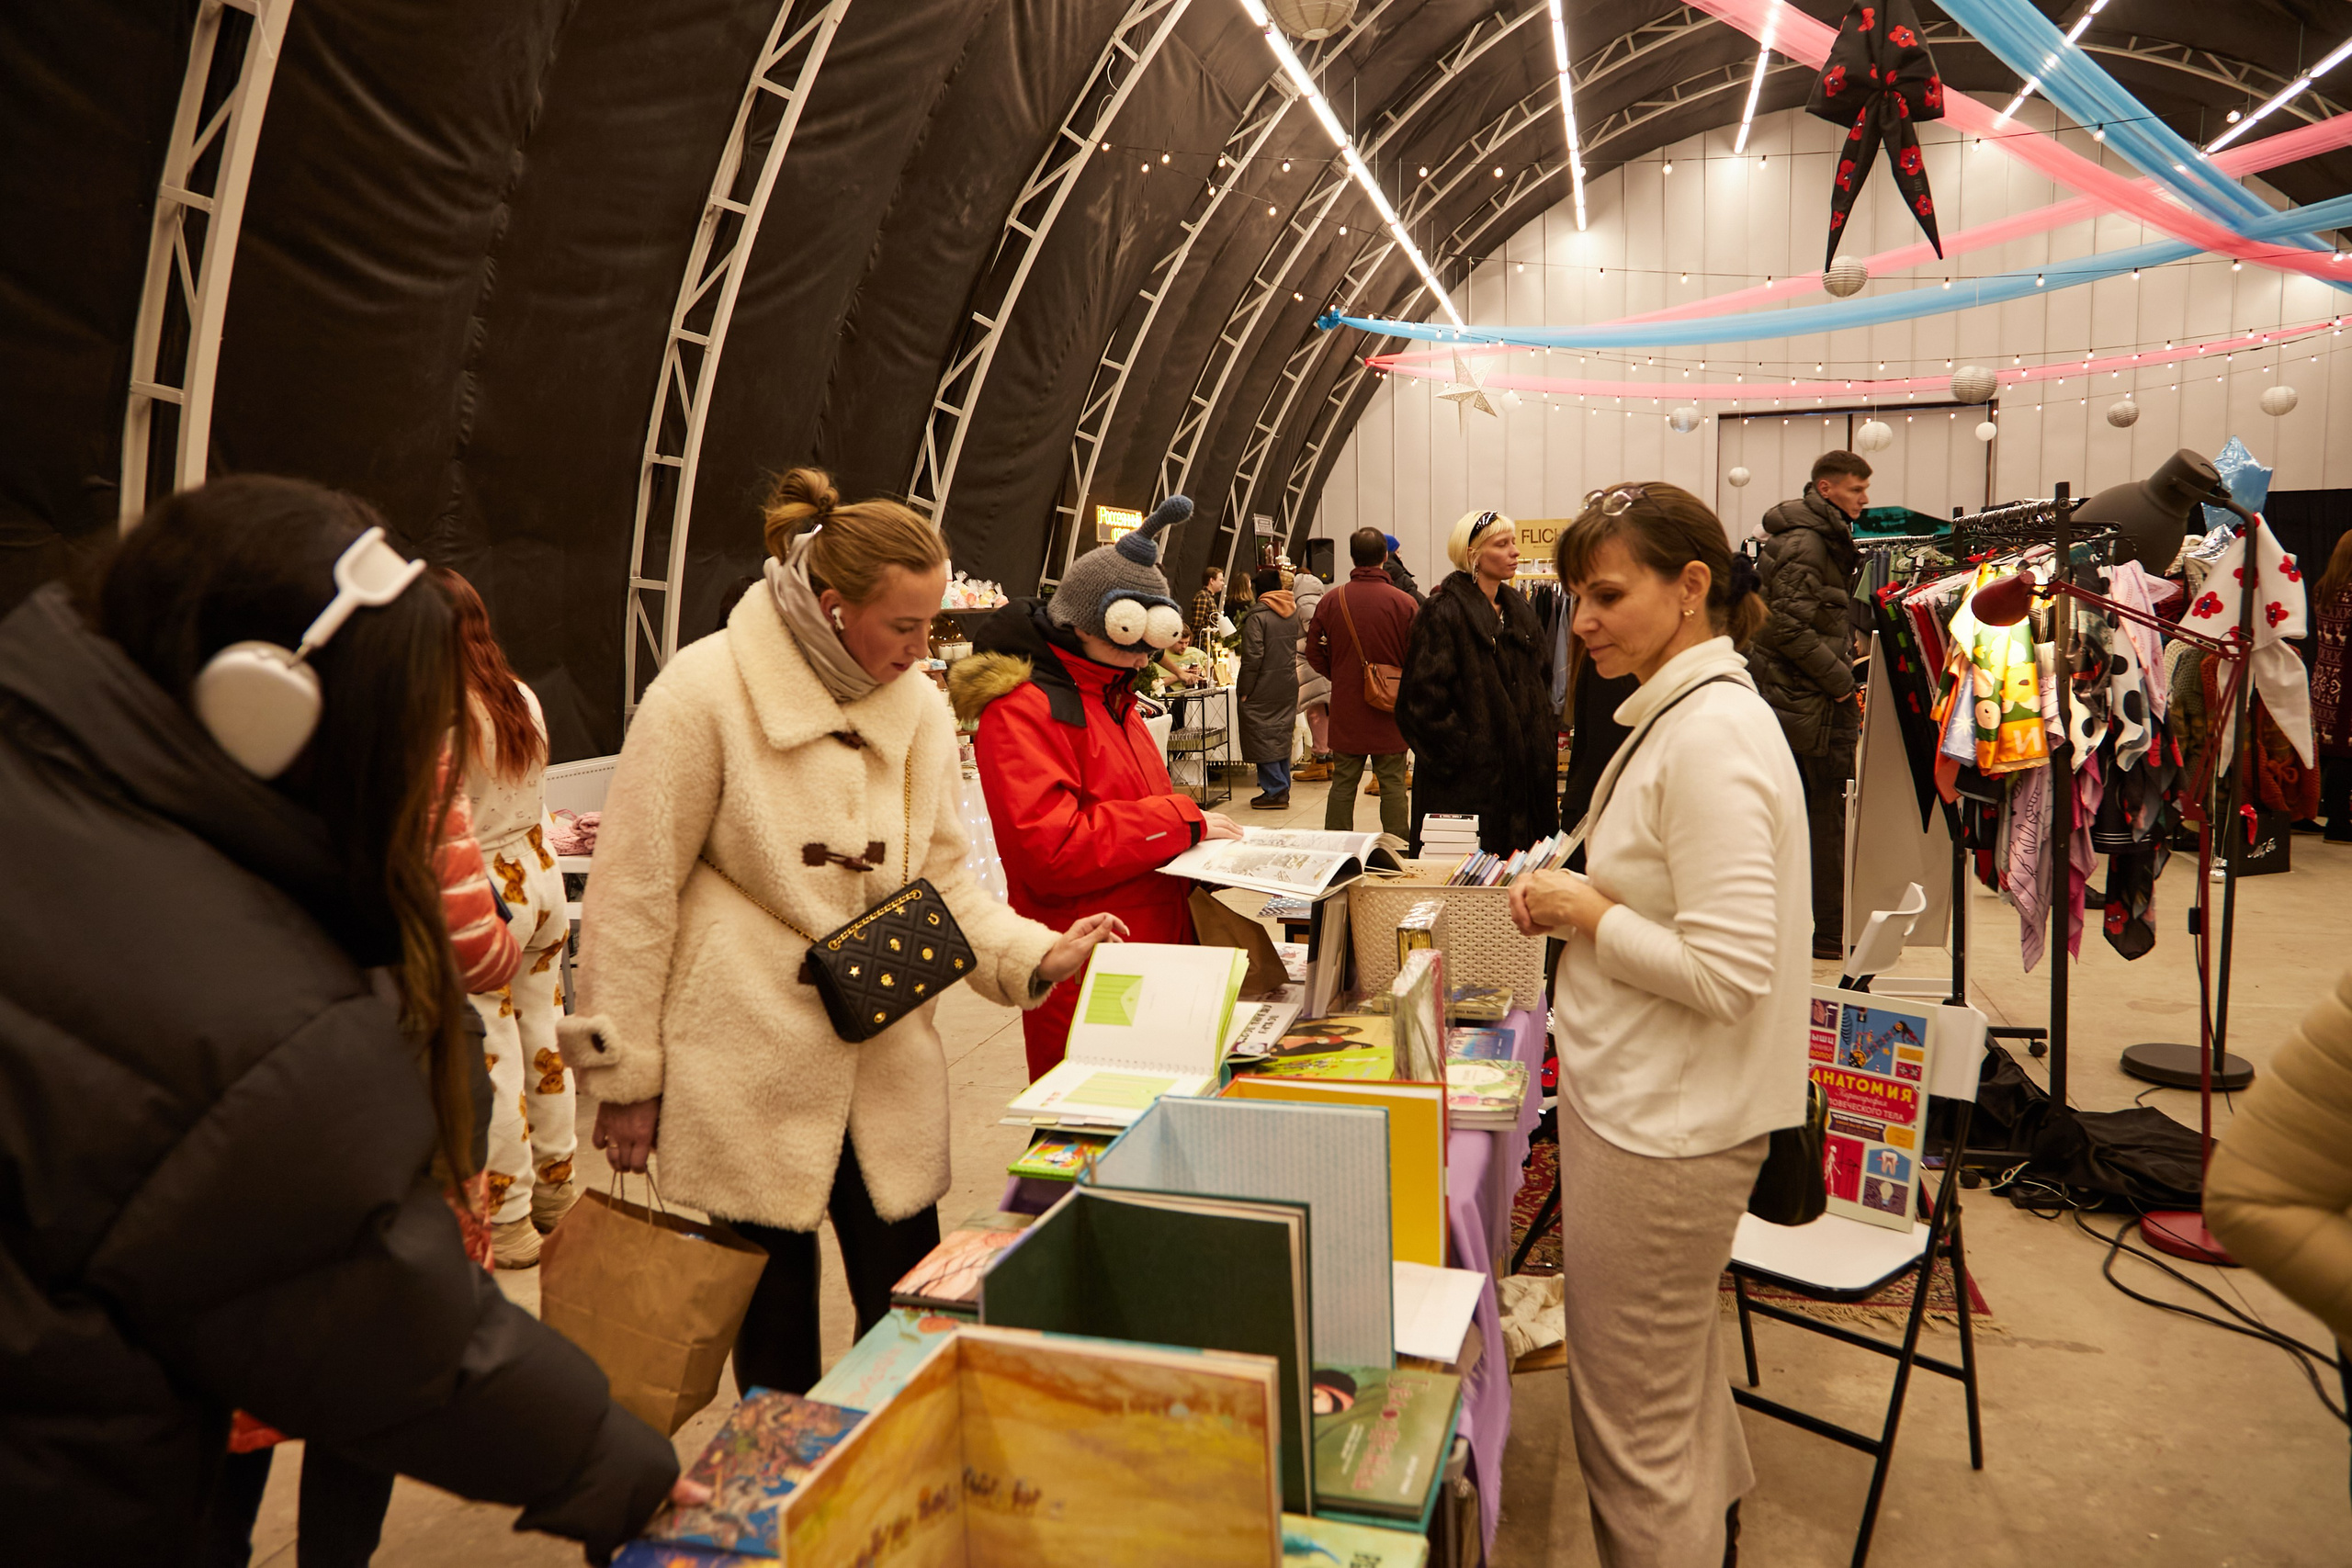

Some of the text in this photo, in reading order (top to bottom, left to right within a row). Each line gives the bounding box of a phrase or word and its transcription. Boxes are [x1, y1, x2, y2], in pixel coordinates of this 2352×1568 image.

[1811, 1033, 1834, 1045] ЫШЦ
[1812, 1068, 1913, 1103] АНАТОМИЯ
[1828, 1097, 1882, 1116] ЛОВЕЧЕСКОГО
[1883, 1109, 1905, 1122] ТЕЛА
